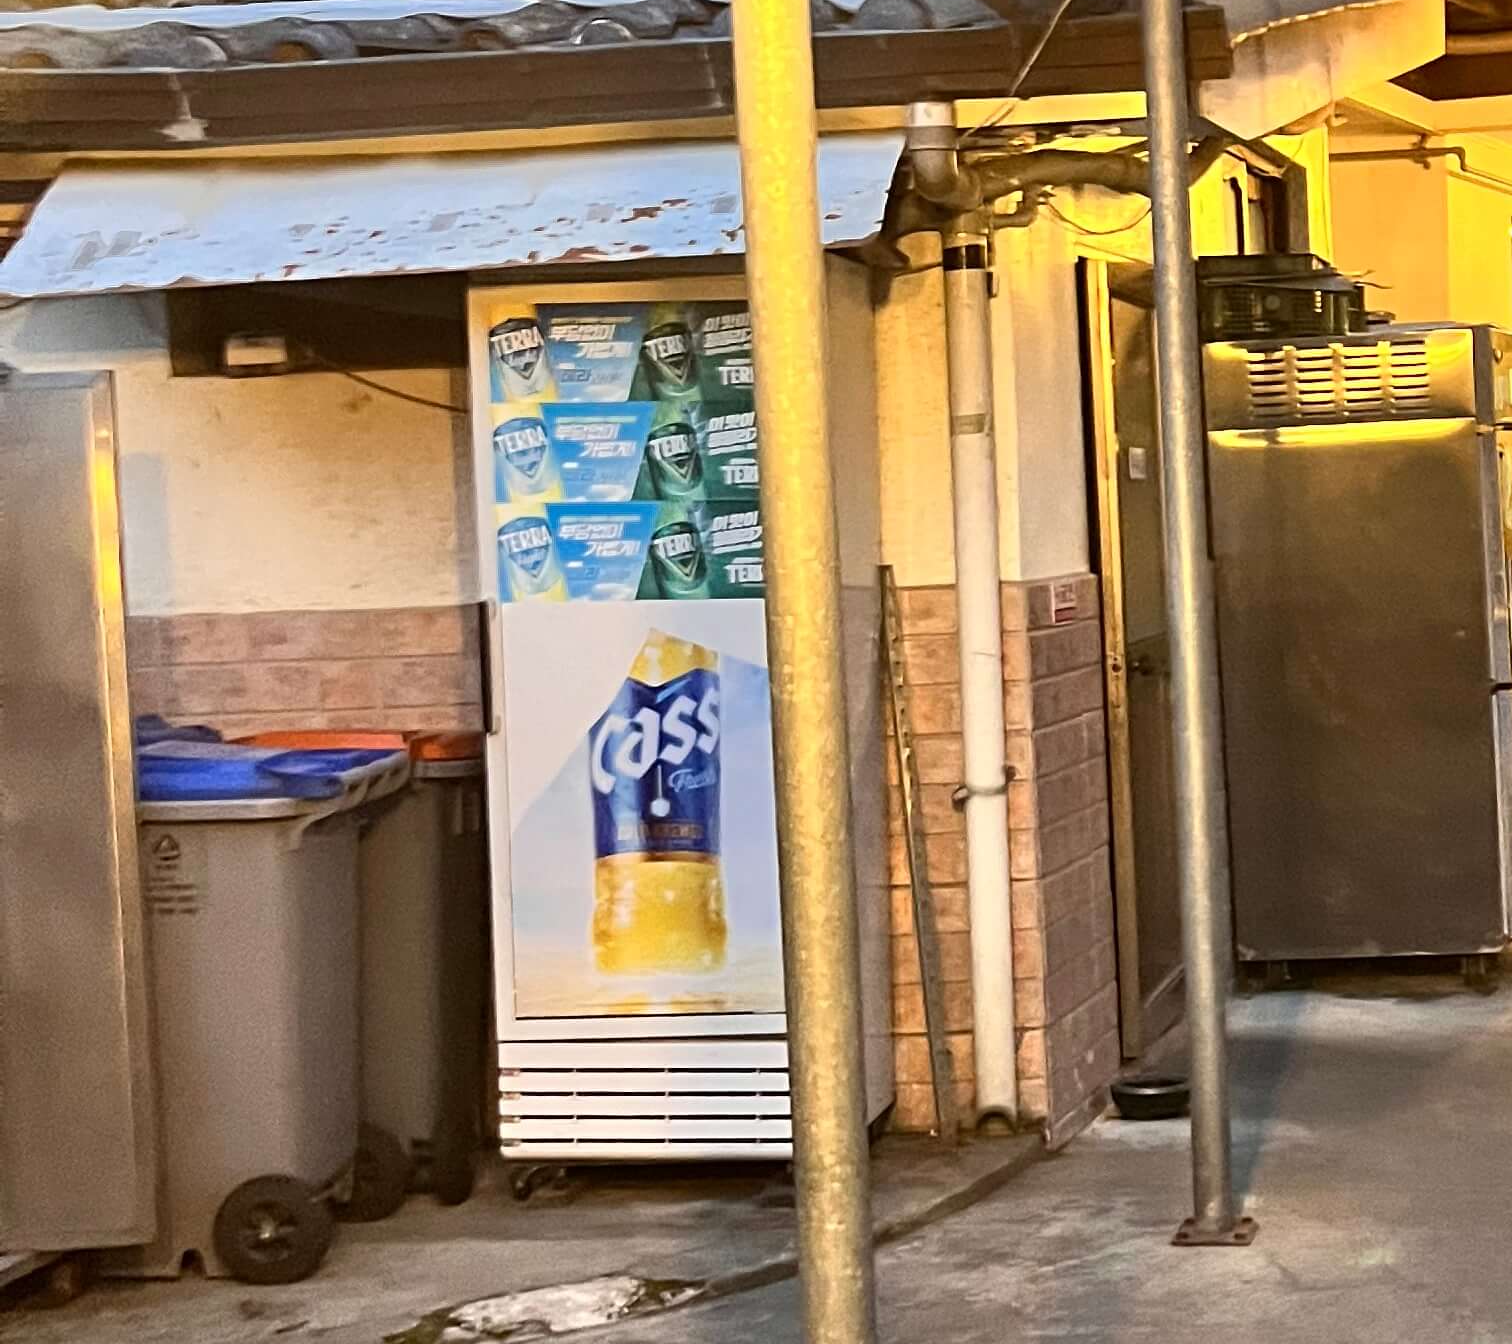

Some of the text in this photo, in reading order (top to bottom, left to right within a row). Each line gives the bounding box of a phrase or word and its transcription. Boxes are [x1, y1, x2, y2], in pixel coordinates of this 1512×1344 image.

[490, 326, 545, 358] TERRA
[495, 426, 548, 455] TERRA
[499, 525, 552, 554] TERRA
